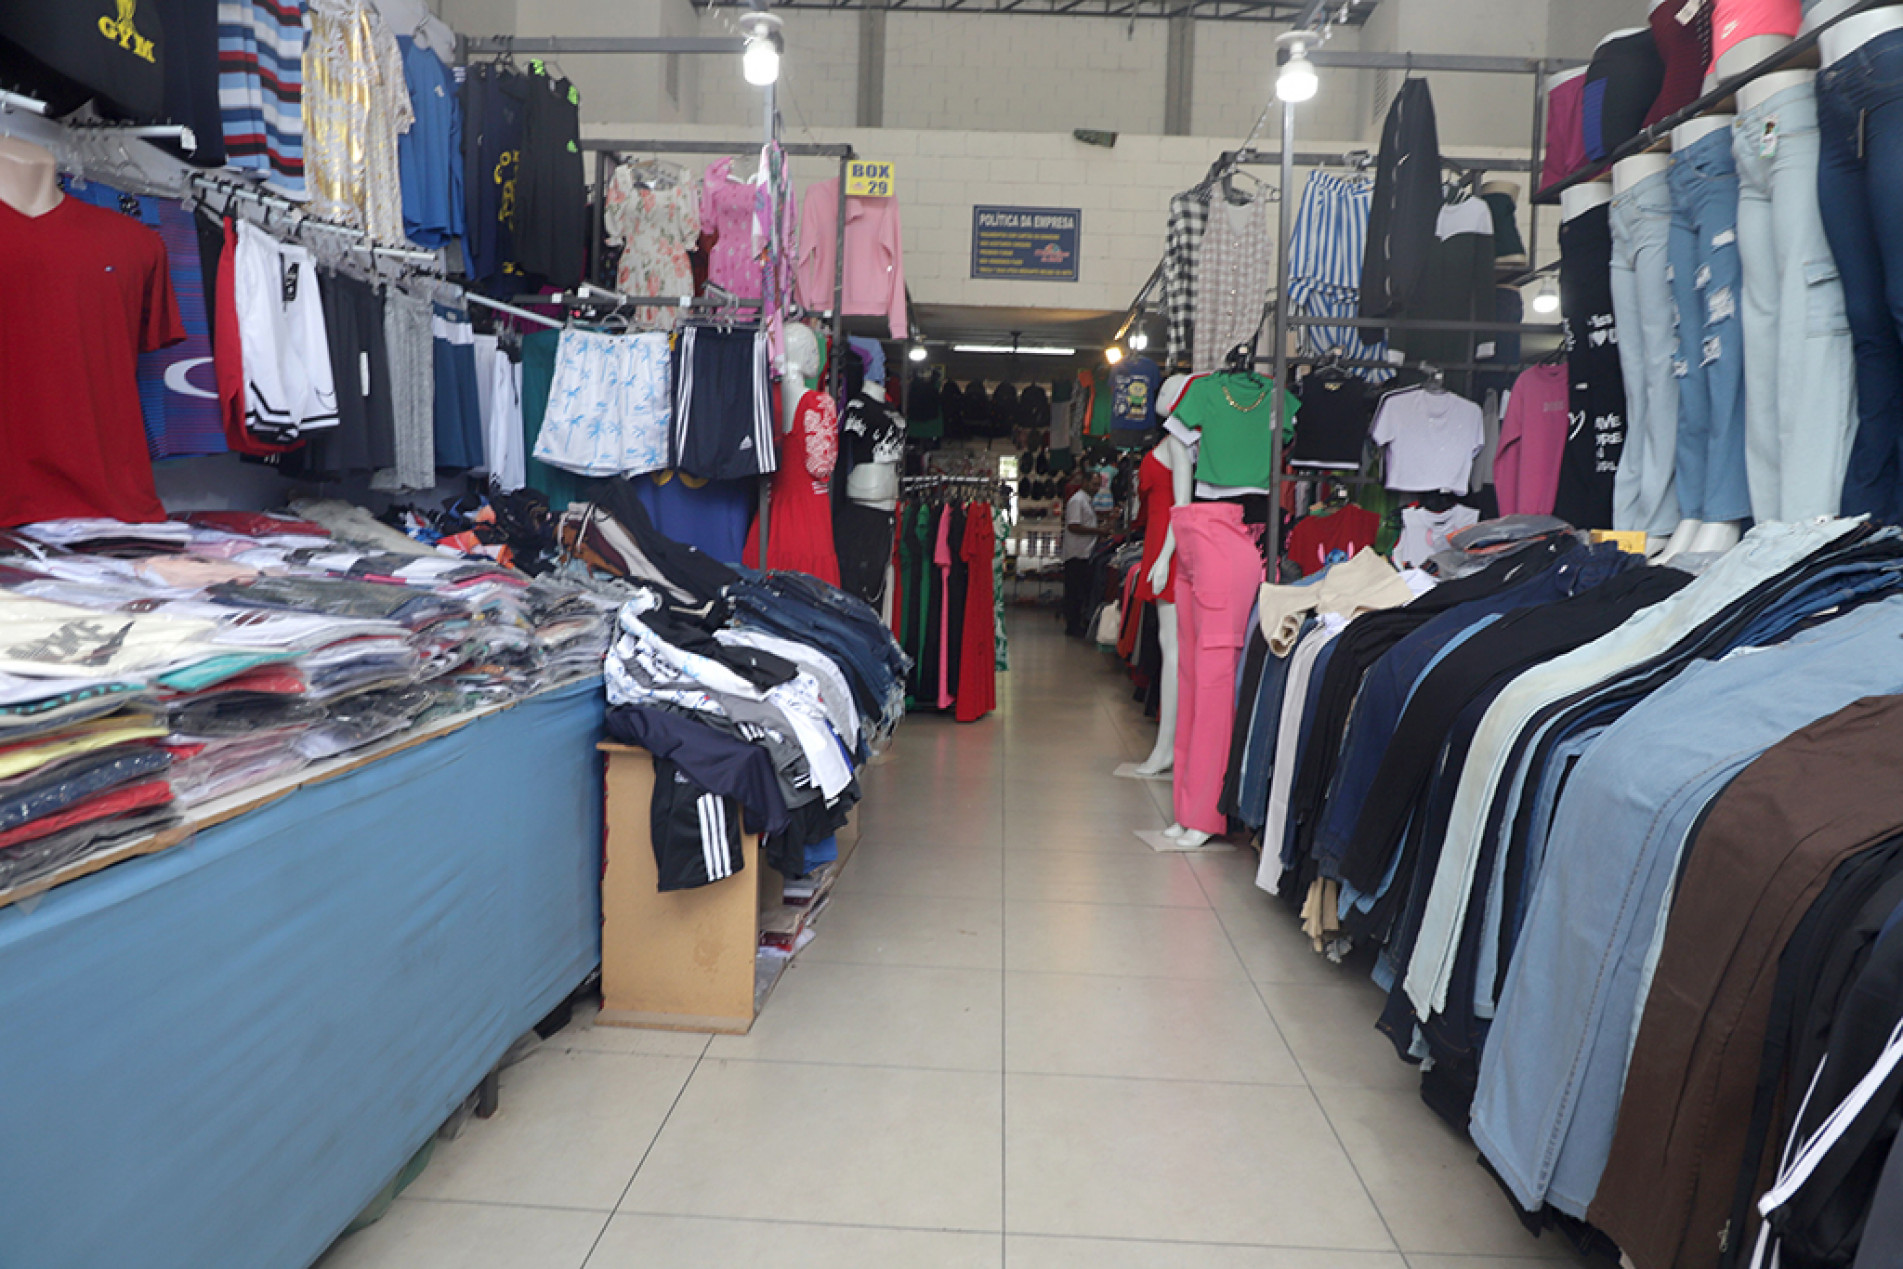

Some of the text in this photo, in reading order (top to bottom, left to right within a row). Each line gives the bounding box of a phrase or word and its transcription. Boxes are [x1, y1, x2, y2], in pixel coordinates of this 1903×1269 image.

[98, 15, 156, 63] GYM
[852, 163, 890, 179] BOX
[867, 181, 888, 195] 29
[1020, 213, 1033, 228] DA
[1034, 214, 1075, 229] EMPRESA
